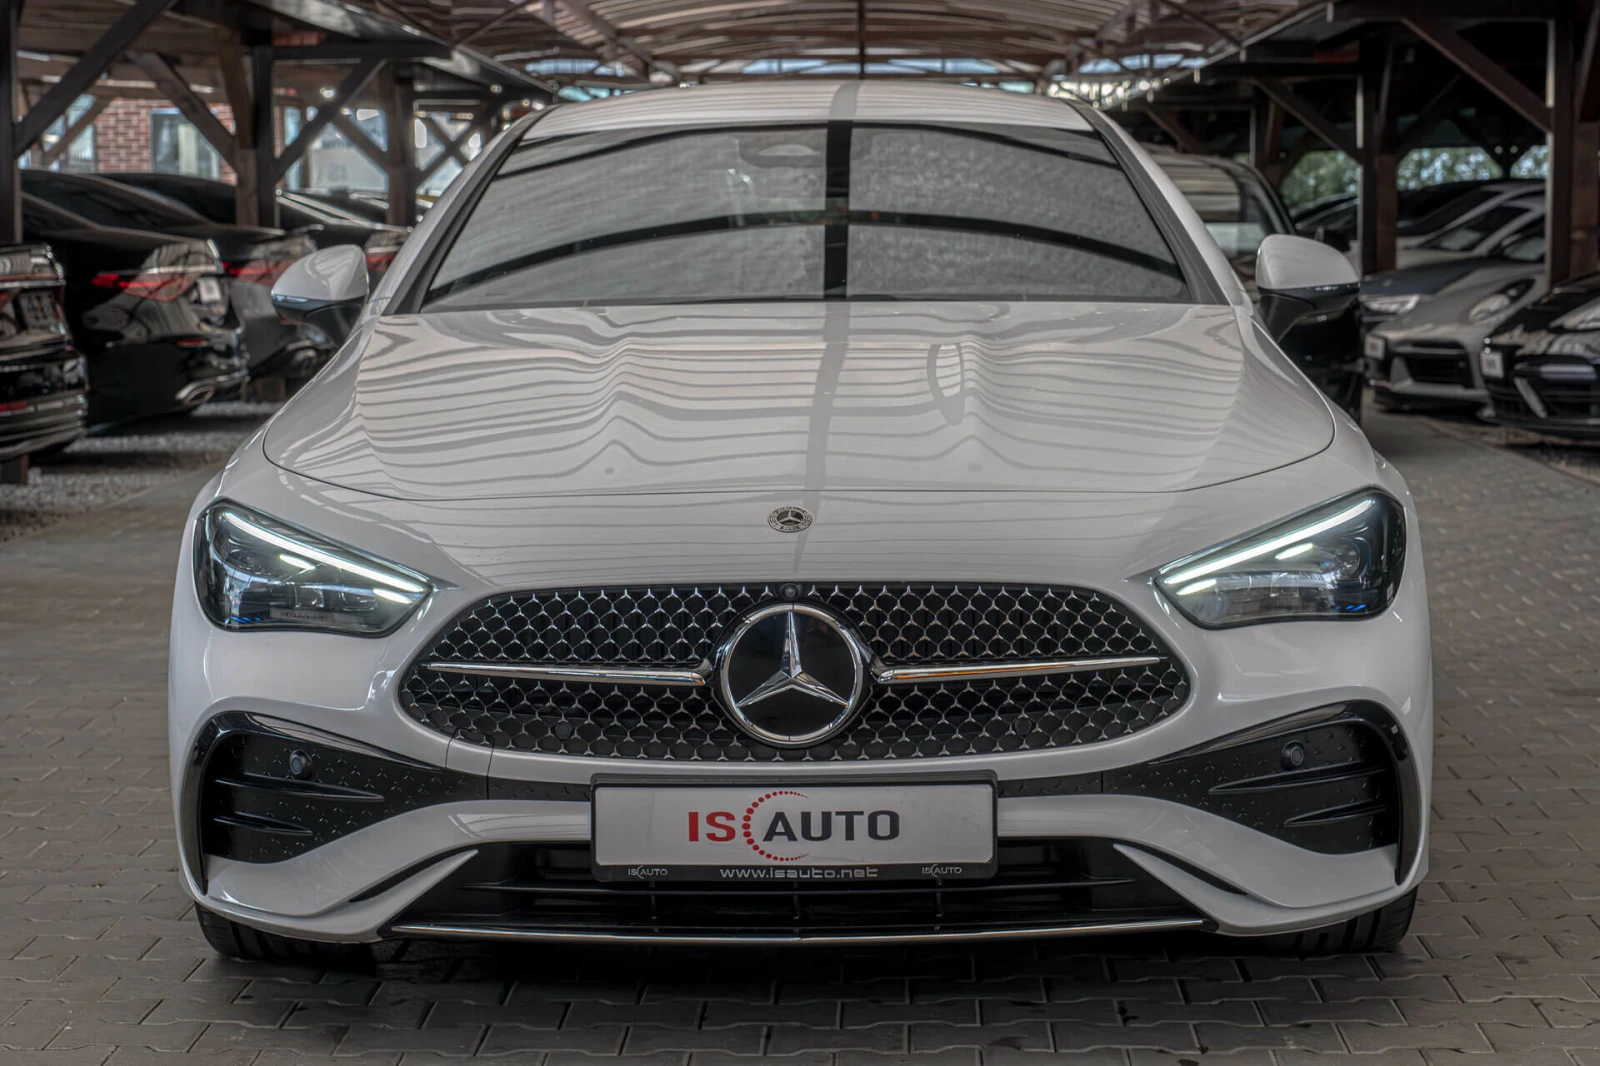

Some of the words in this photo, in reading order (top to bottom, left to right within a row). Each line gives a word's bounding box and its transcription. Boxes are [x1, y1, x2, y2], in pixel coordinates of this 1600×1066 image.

[688, 811, 736, 842] IS
[762, 810, 900, 842] AUTO
[719, 866, 879, 879] www.isauto.net
